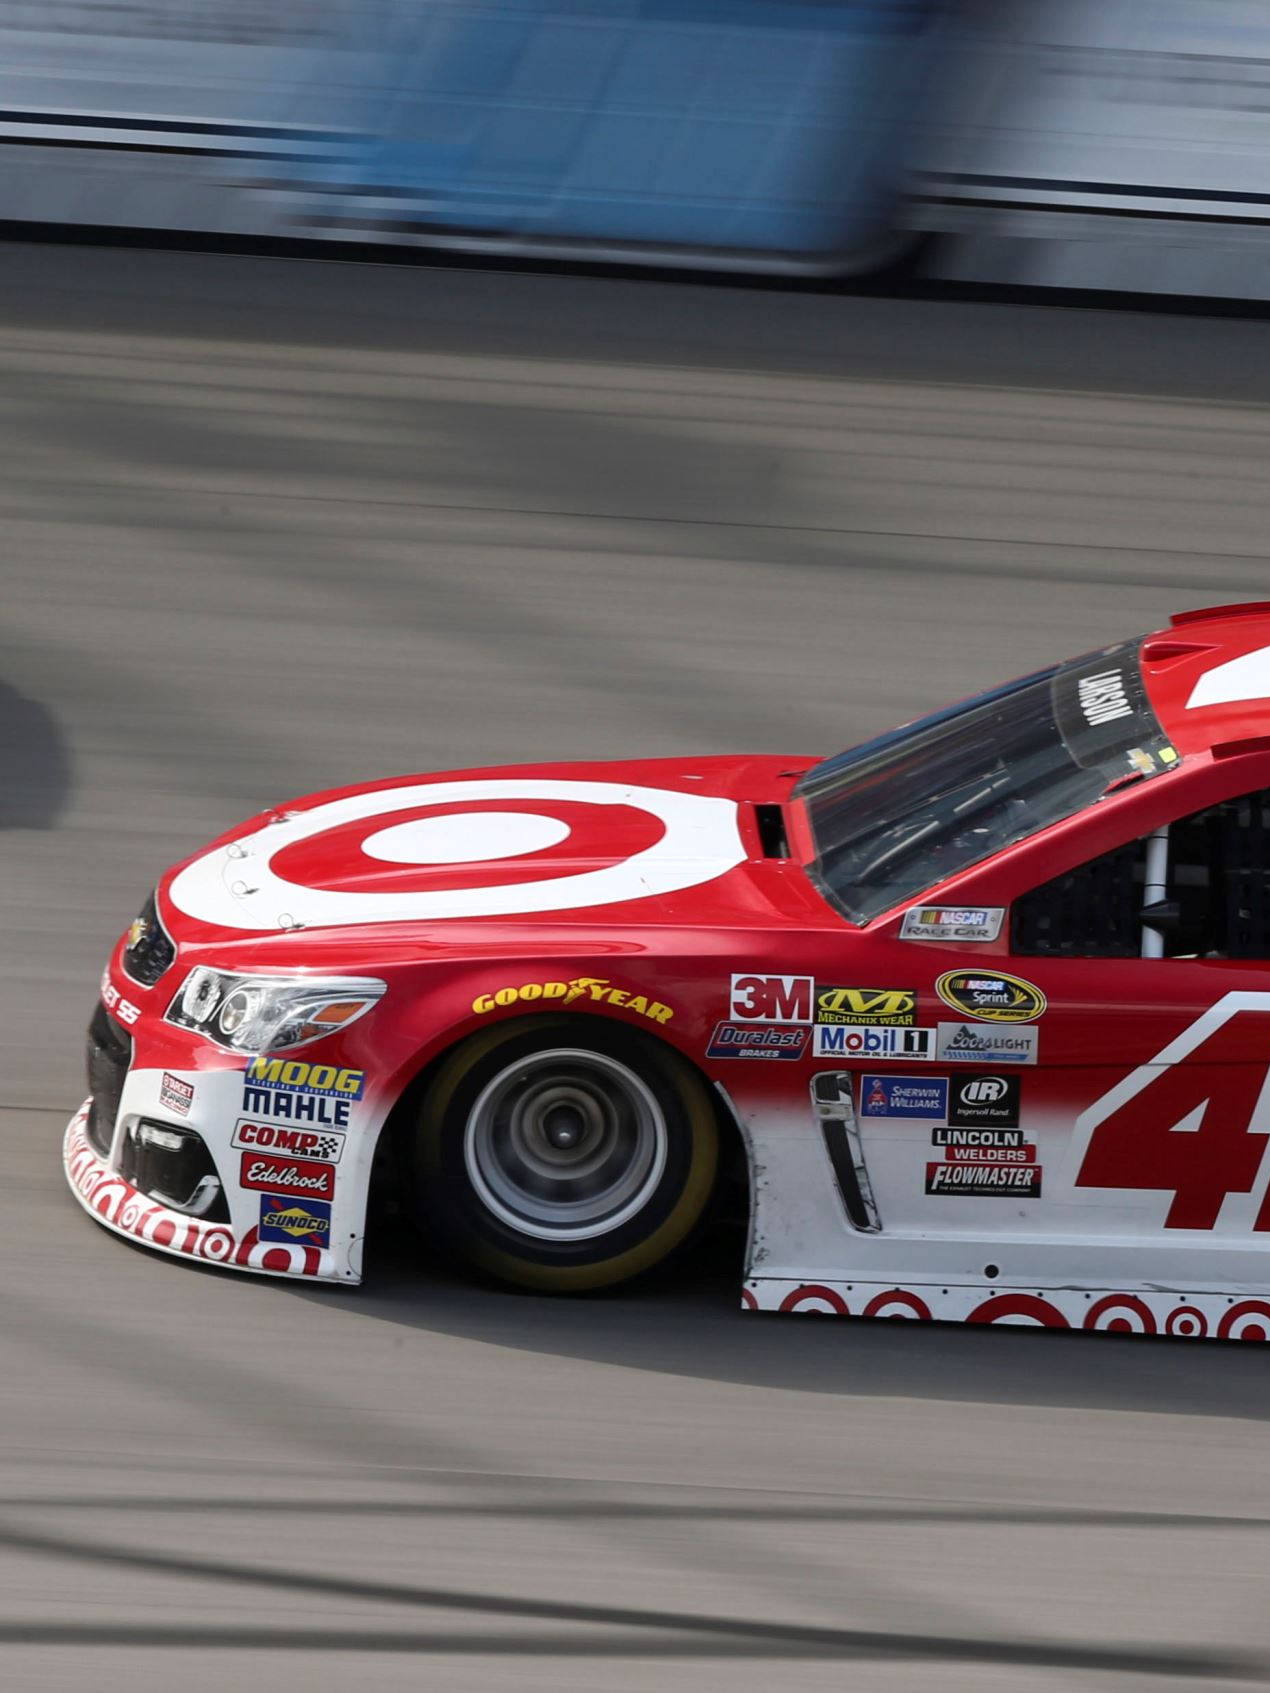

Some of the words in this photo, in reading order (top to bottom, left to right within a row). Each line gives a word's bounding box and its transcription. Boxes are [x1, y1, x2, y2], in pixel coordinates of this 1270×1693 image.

[1078, 668, 1134, 726] LARSON
[940, 911, 985, 925] NASCAR
[907, 927, 951, 936] RACE
[954, 928, 989, 937] CAR
[967, 980, 1006, 990] NASCAR
[733, 977, 811, 1020] 3M
[972, 991, 1009, 1004] Sprint
[818, 1011, 878, 1024] MECHANIX
[879, 1014, 914, 1025] WEAR
[718, 1026, 804, 1047] Duralast
[821, 1027, 896, 1051] Mobil
[994, 1039, 1032, 1050] LIGHT
[739, 1048, 780, 1057] BRAKES
[248, 1056, 364, 1094] MOOG
[891, 1086, 940, 1098] SHERWIN
[967, 1082, 1001, 1101] IR
[243, 1087, 351, 1127] MAHLE
[889, 1097, 942, 1109] WILLIAMS
[957, 1107, 988, 1116] Ingersoll
[989, 1108, 1010, 1116] Rand
[239, 1125, 319, 1149] COMP
[936, 1130, 1019, 1146] LINCOLN
[291, 1147, 330, 1159] CAMS
[954, 1149, 1027, 1161] WELDERS
[247, 1162, 328, 1191] Edelbrock
[931, 1166, 1034, 1190] FLOWMASTER
[266, 1213, 327, 1230] SUNOCO
